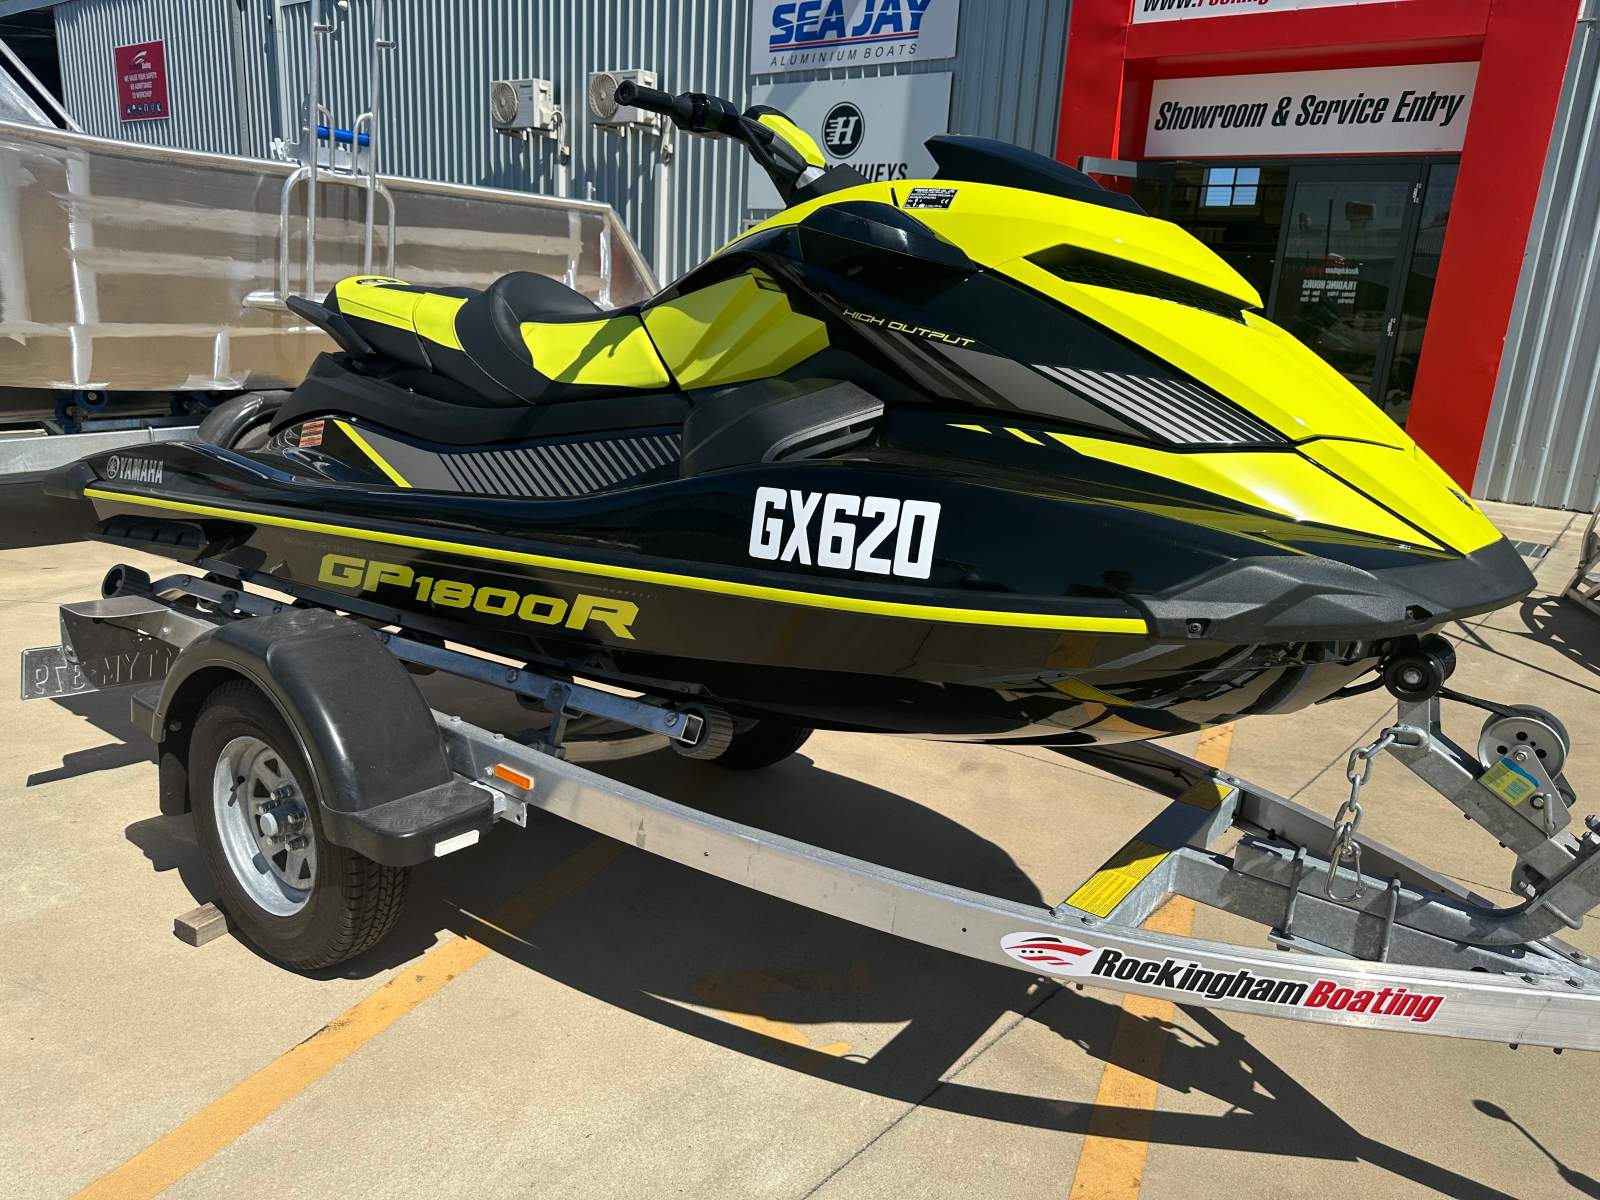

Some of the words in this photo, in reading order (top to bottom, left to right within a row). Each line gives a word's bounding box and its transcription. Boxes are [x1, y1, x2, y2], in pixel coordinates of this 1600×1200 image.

[769, 0, 846, 45] SEA
[851, 0, 931, 37] JAY
[770, 49, 858, 68] ALUMINIUM
[864, 43, 918, 60] BOATS
[1154, 101, 1269, 131] Showroom
[1271, 96, 1293, 127] &
[1295, 92, 1390, 126] Service
[1392, 90, 1466, 127] Entry
[842, 309, 886, 326] HIGH
[887, 321, 976, 346] OUTPUT
[118, 456, 164, 485] YAMAHA
[748, 486, 942, 580] GX620
[317, 553, 640, 641] GP1800R
[1090, 948, 1310, 1006] Rockingham
[1303, 980, 1446, 1023] Boating
